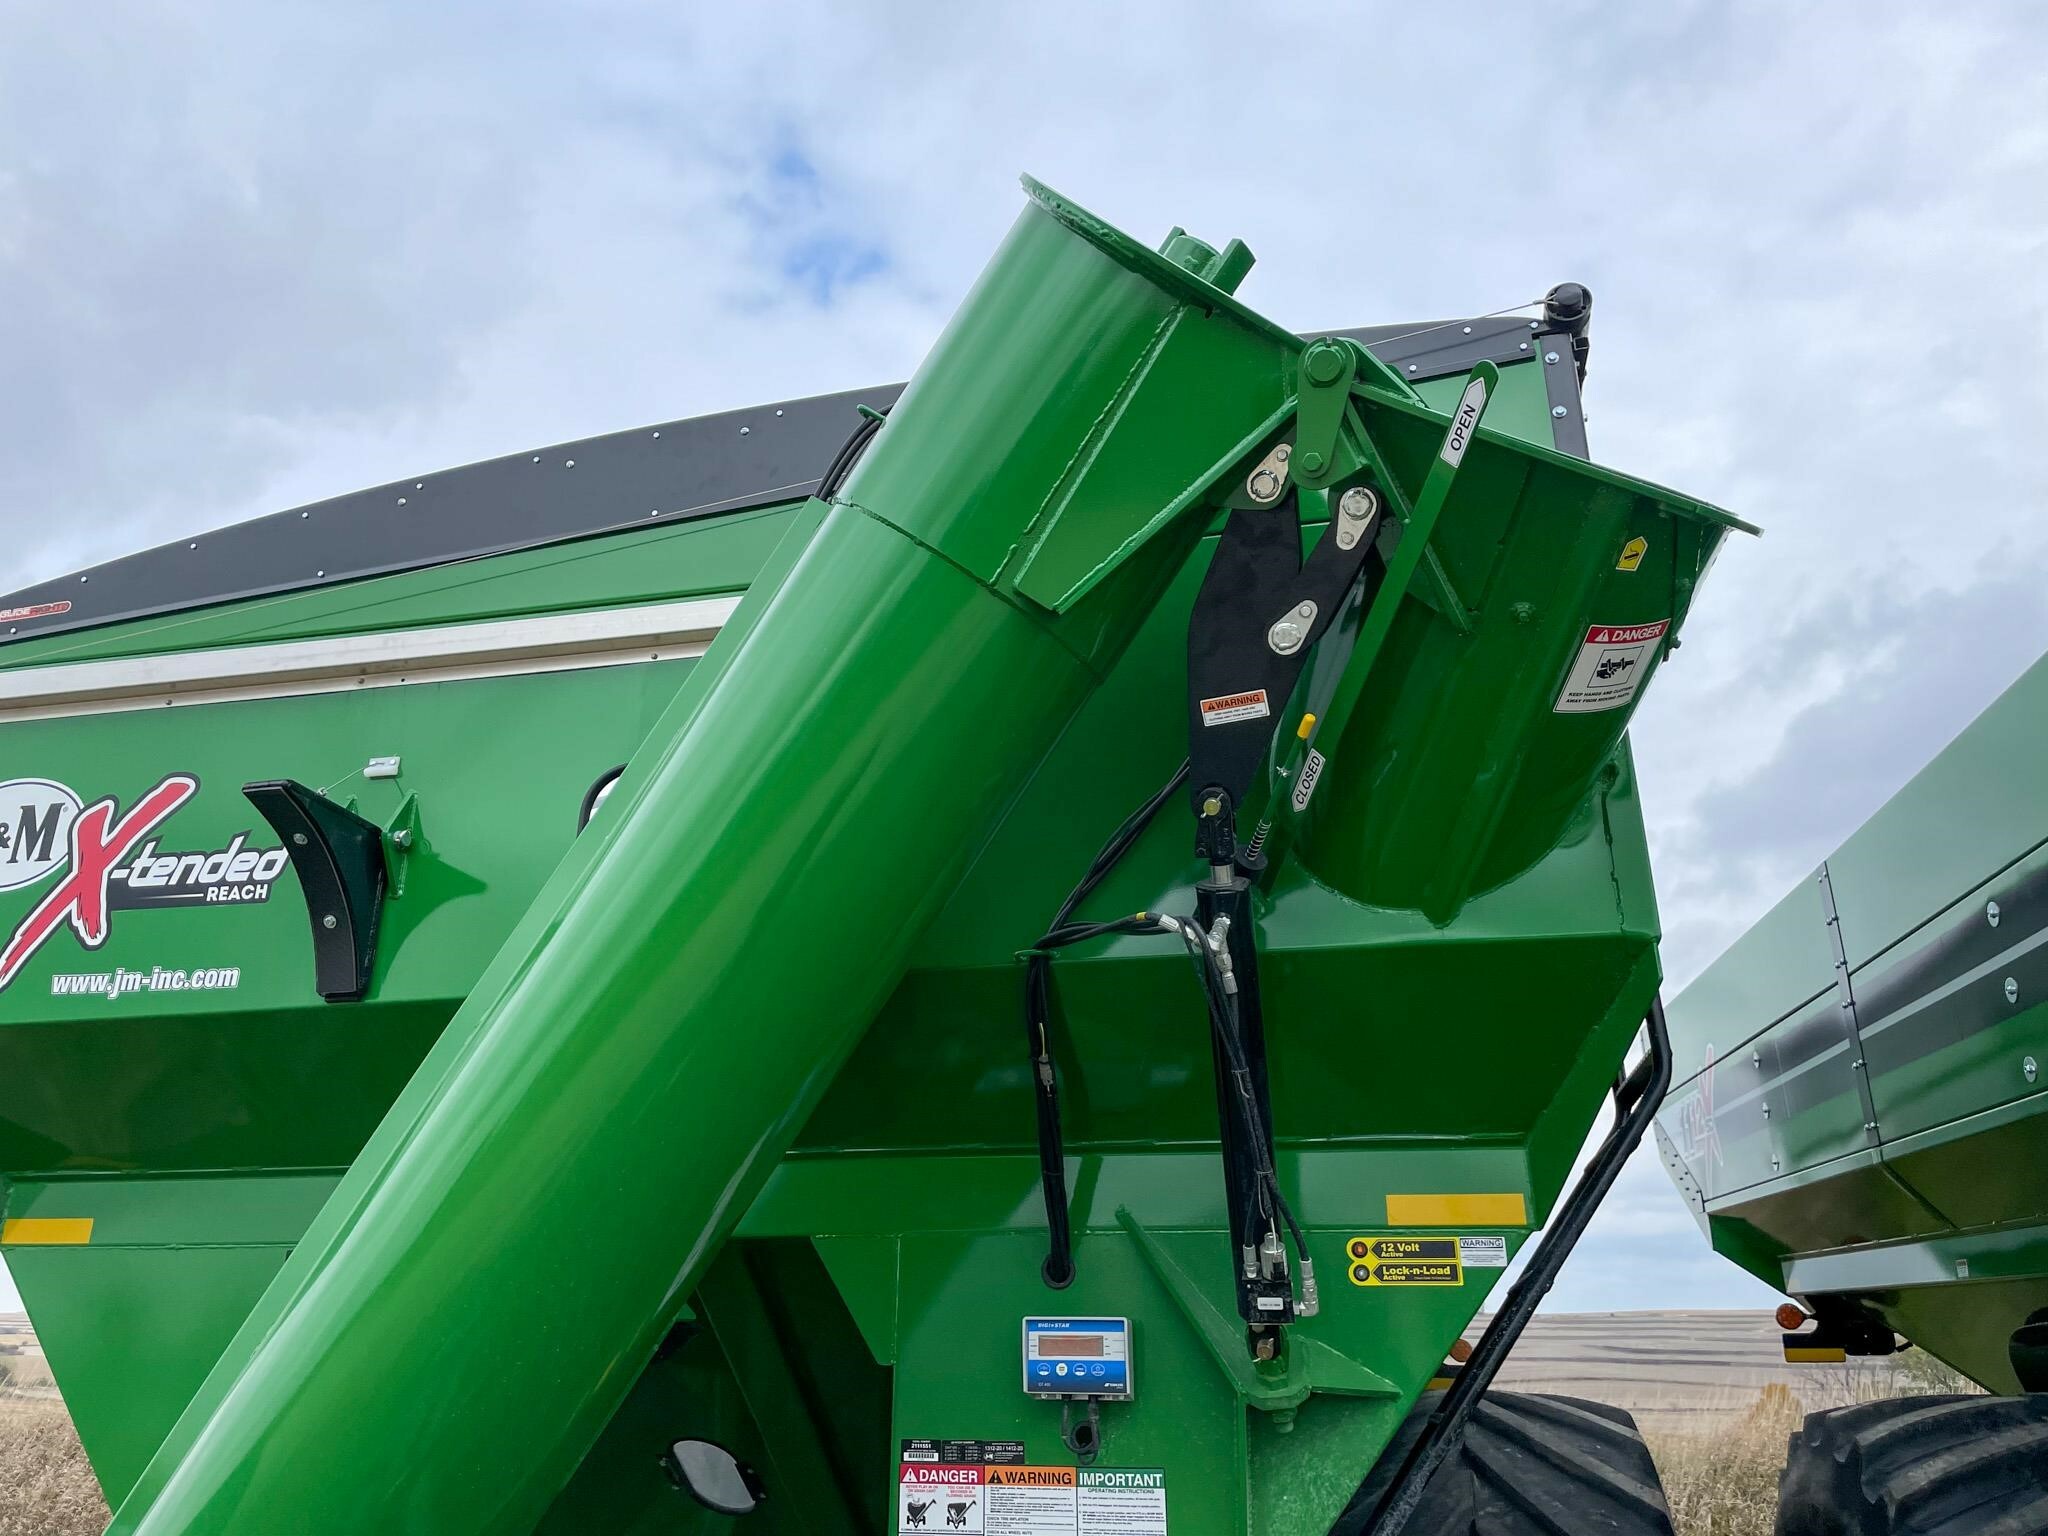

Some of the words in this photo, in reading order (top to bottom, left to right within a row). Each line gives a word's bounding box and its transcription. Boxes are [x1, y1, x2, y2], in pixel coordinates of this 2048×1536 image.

[1450, 404, 1476, 451] OPEN
[1611, 625, 1662, 641] DANGER
[1215, 694, 1260, 709] WARNING
[1296, 755, 1321, 804] CLOSED
[206, 884, 268, 902] REACH
[52, 967, 240, 999] www.jm-inc.com
[1380, 1243, 1394, 1252] 12
[1397, 1243, 1420, 1252] Volt
[1462, 1239, 1503, 1247] WARNING
[1383, 1266, 1451, 1275] Lock-n-Load
[919, 1469, 978, 1483] DANGER
[1005, 1472, 1072, 1485] WARNING
[1079, 1472, 1163, 1487] IMPORTANT
